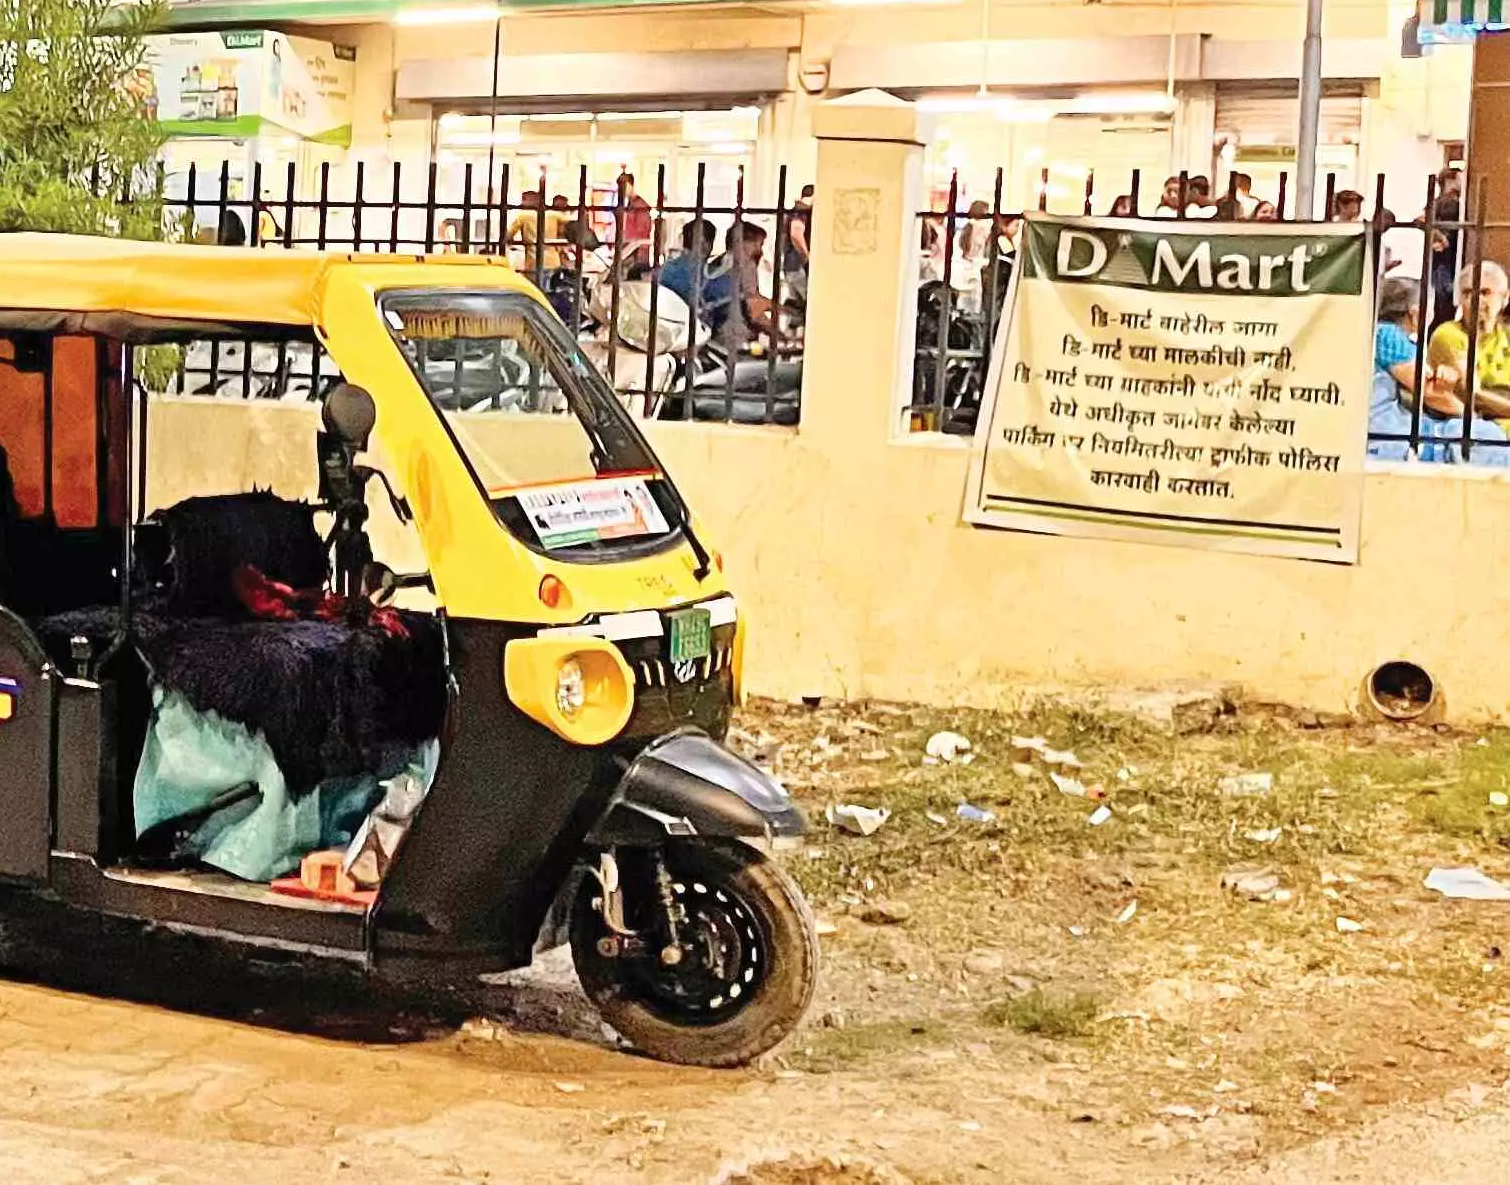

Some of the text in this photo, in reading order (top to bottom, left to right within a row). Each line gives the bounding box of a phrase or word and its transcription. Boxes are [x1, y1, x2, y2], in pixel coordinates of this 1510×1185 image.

[1055, 228, 1315, 293] D Mart
[1160, 311, 1226, 336] बाहेरील
[1233, 320, 1279, 337] जागा
[1163, 343, 1246, 368] मालकीची
[1049, 394, 1078, 418] येथे
[1229, 408, 1296, 437] केलेल्या
[1278, 445, 1341, 473] पोलिस
[1090, 467, 1161, 495] कारवाही
